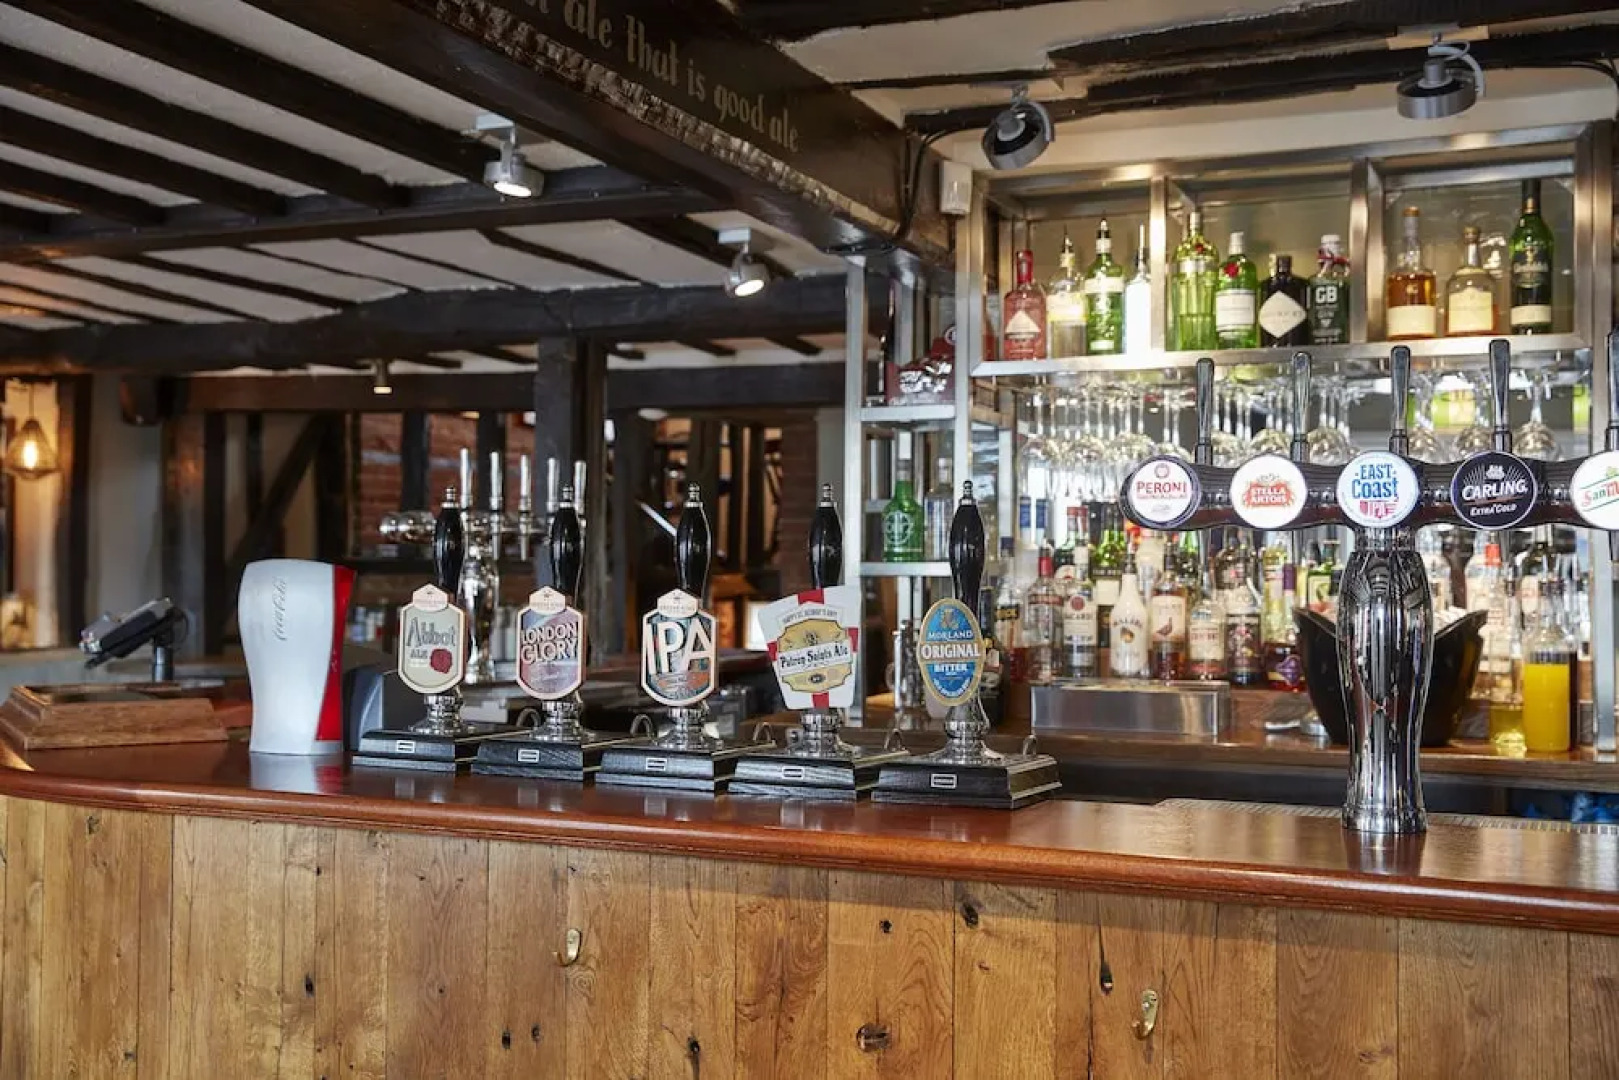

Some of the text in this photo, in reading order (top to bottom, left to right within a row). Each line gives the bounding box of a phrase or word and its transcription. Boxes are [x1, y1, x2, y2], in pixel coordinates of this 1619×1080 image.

[564, 0, 799, 152] ale that is good ale
[1315, 285, 1338, 304] GB
[1360, 463, 1393, 480] EAST
[1136, 481, 1188, 494] PERONI
[1250, 487, 1286, 496] STELLA
[1352, 477, 1399, 499] Coast
[1461, 479, 1528, 501] CARLING
[406, 616, 456, 648] Abbot
[520, 623, 577, 643] LONDON
[928, 630, 974, 641] MORLAND
[521, 637, 577, 665] GLORY
[645, 617, 713, 675] IPA
[921, 643, 981, 660] ORIGINAL
[933, 662, 968, 673] BITTER
